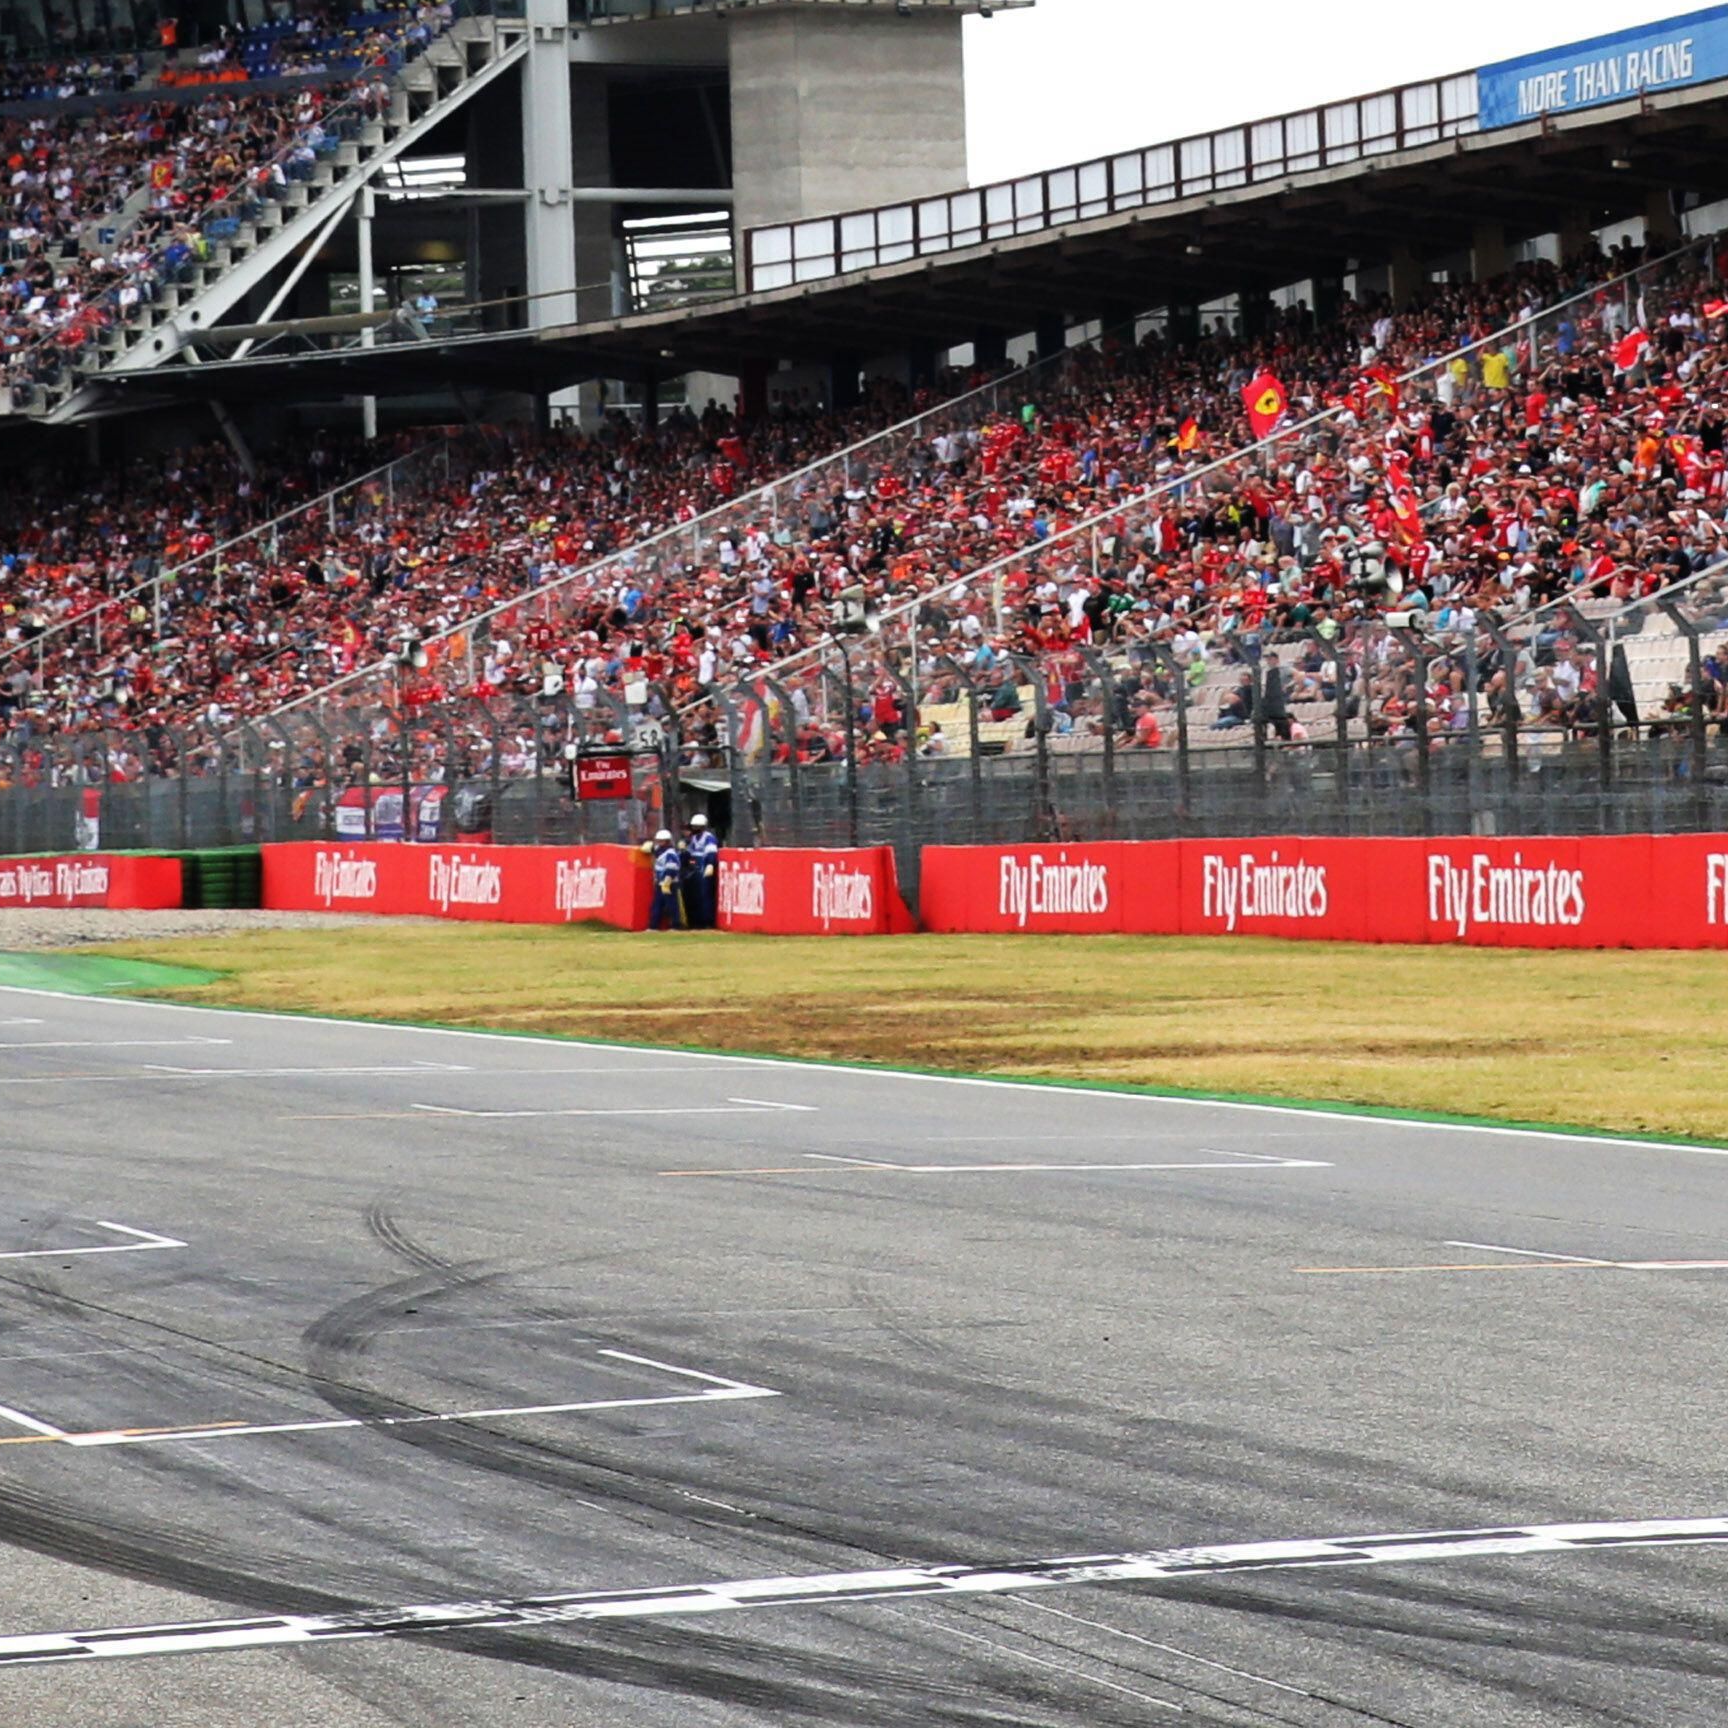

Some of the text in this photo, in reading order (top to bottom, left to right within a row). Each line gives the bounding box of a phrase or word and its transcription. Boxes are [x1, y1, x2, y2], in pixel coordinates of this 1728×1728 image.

[1518, 38, 1694, 116] MORE THAN RACING
[580, 770, 628, 782] Emirates
[315, 852, 333, 907] Fly
[430, 853, 502, 912] Fly Emirates
[1000, 851, 1108, 927] Fly Emirates
[1204, 850, 1327, 931] Fly Emirates
[1428, 852, 1585, 937] Fly Emirates
